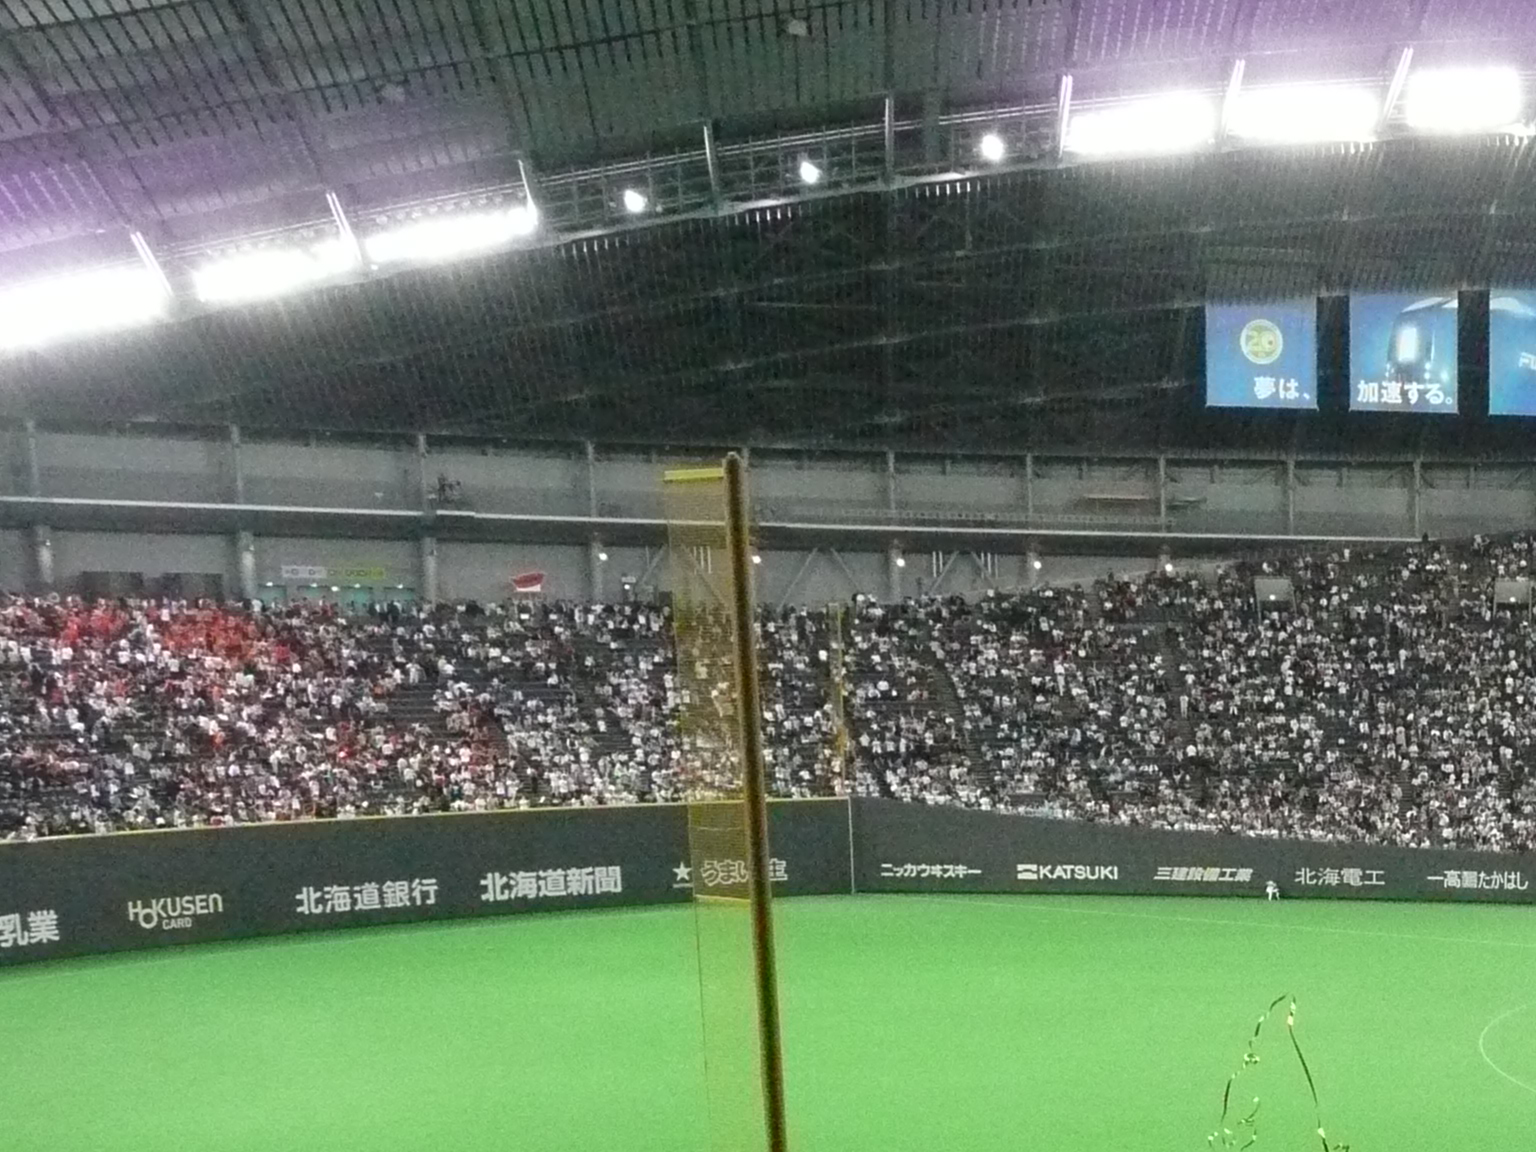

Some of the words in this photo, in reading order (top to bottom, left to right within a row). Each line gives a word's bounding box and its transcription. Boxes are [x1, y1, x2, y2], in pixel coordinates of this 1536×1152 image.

[1356, 380, 1454, 406] 加速する。
[480, 865, 623, 903] 北海道新聞
[1038, 864, 1119, 882] KATSUKI
[1294, 867, 1386, 887] 北海電工
[295, 877, 438, 916] 北海道銀行
[161, 917, 193, 931] CARD
